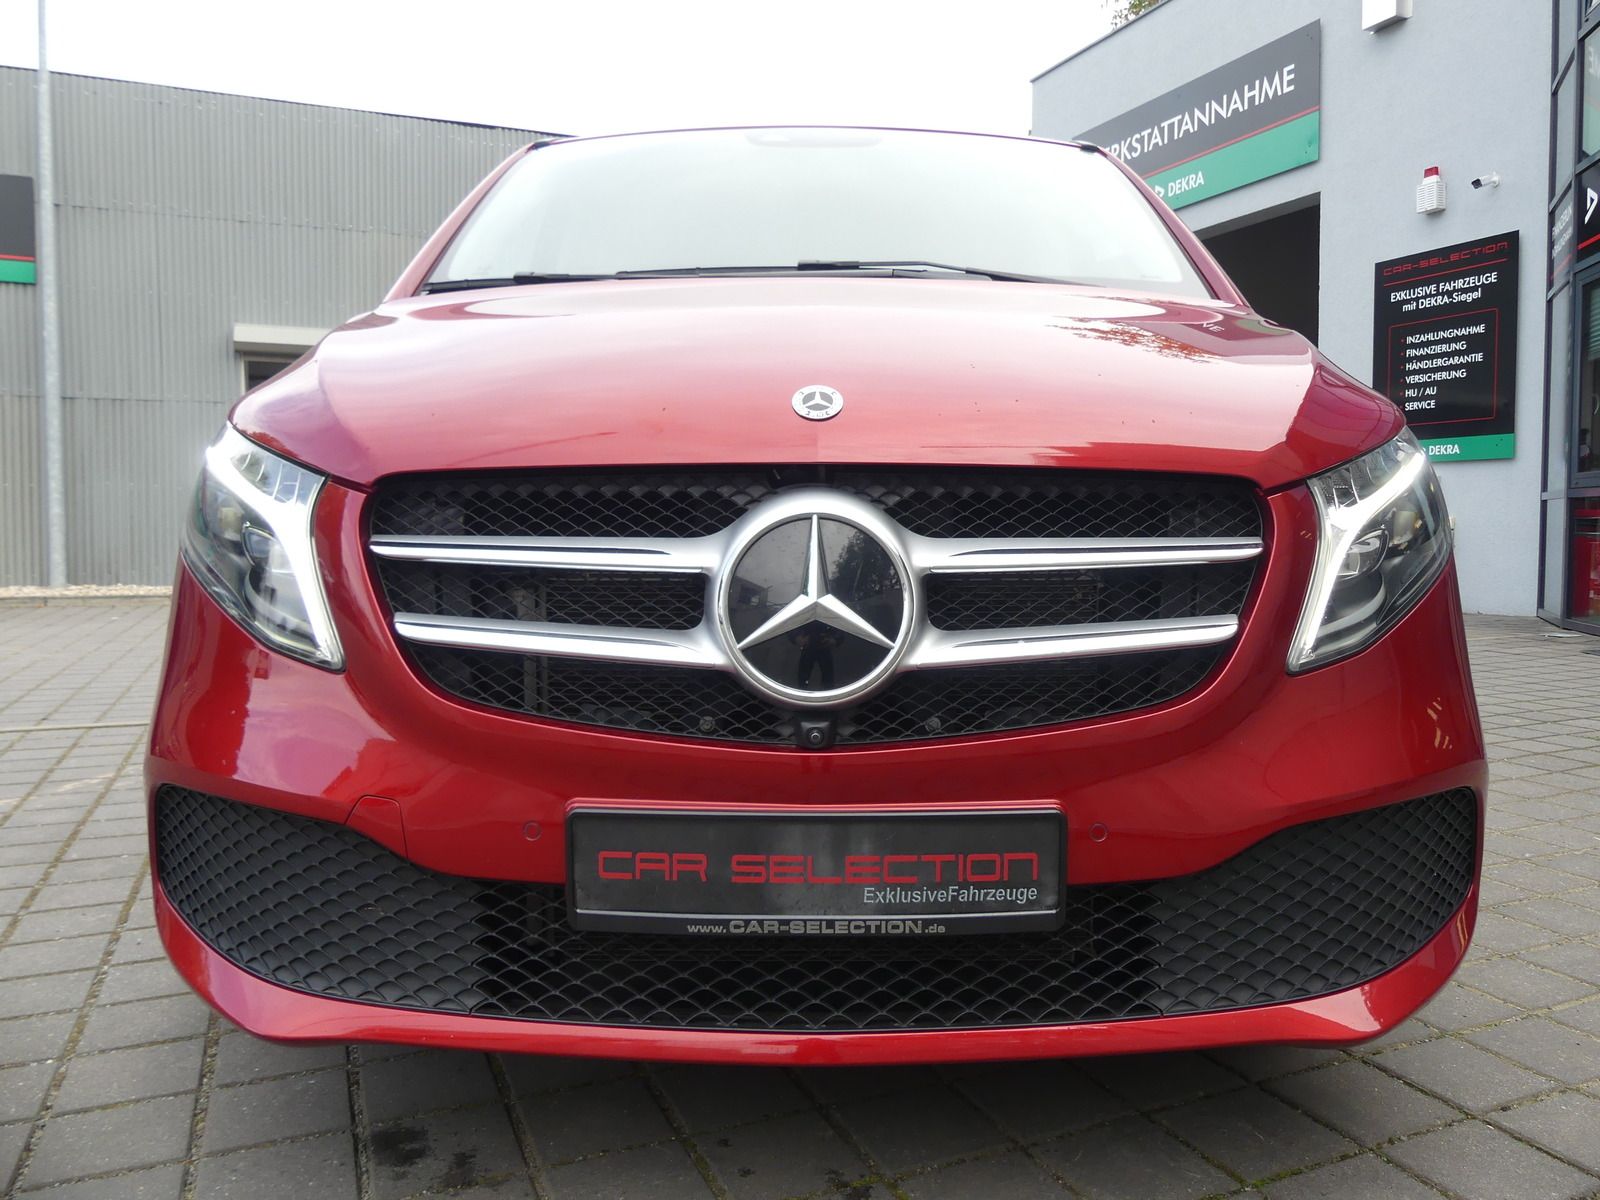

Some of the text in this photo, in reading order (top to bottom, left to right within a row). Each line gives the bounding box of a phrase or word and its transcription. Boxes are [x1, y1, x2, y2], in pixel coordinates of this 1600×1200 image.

[1167, 171, 1205, 197] DEKRA
[1390, 272, 1498, 302] EXKLUSIVE FAHRZEUGE
[1402, 288, 1482, 312] mit DEKRA-Siegel
[1406, 324, 1485, 344] INZAHLUNGNAHME
[1406, 341, 1467, 358] FINANZIERUNG
[1405, 353, 1484, 371] HÄNDLERGARANTIE
[1405, 369, 1467, 384] VERSICHERUNG
[1405, 389, 1418, 398] HU
[1424, 386, 1437, 396] AU
[1404, 400, 1436, 411] SERVICE
[1428, 444, 1460, 456] DEKRA
[598, 851, 1039, 884] CAR SELECTION
[863, 886, 1038, 905] ExklusiveFahrzeuge
[687, 920, 946, 934] www.CAR-SELECTION.de
